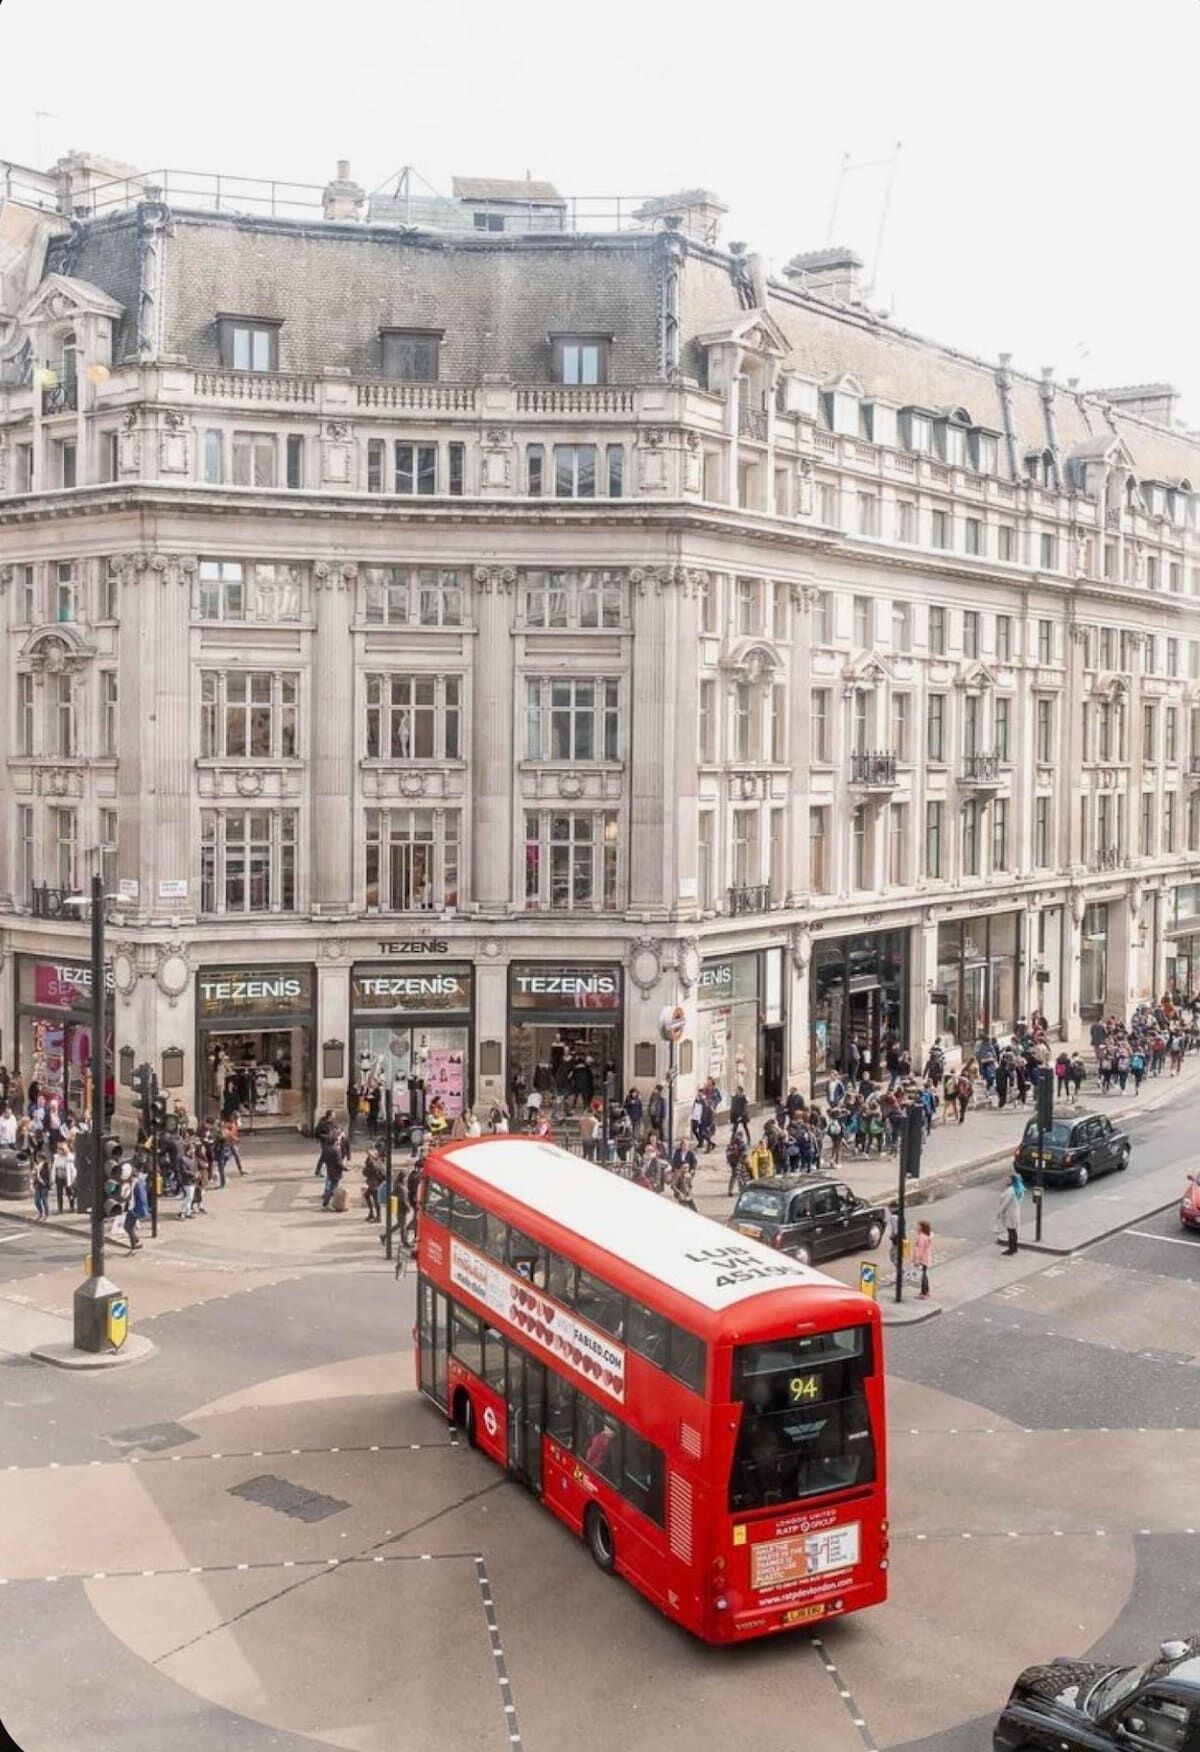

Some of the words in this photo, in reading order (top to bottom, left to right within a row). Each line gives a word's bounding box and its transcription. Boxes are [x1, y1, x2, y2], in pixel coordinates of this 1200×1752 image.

[378, 938, 448, 953] TEZENIS
[201, 976, 301, 999] TEZENIS
[360, 974, 459, 995] TEZENIS
[517, 973, 613, 993] TEZENIS
[685, 1247, 749, 1262] LUB
[712, 1257, 763, 1268] VH
[574, 1329, 622, 1369] FABLED.COM
[790, 1377, 817, 1400] 94
